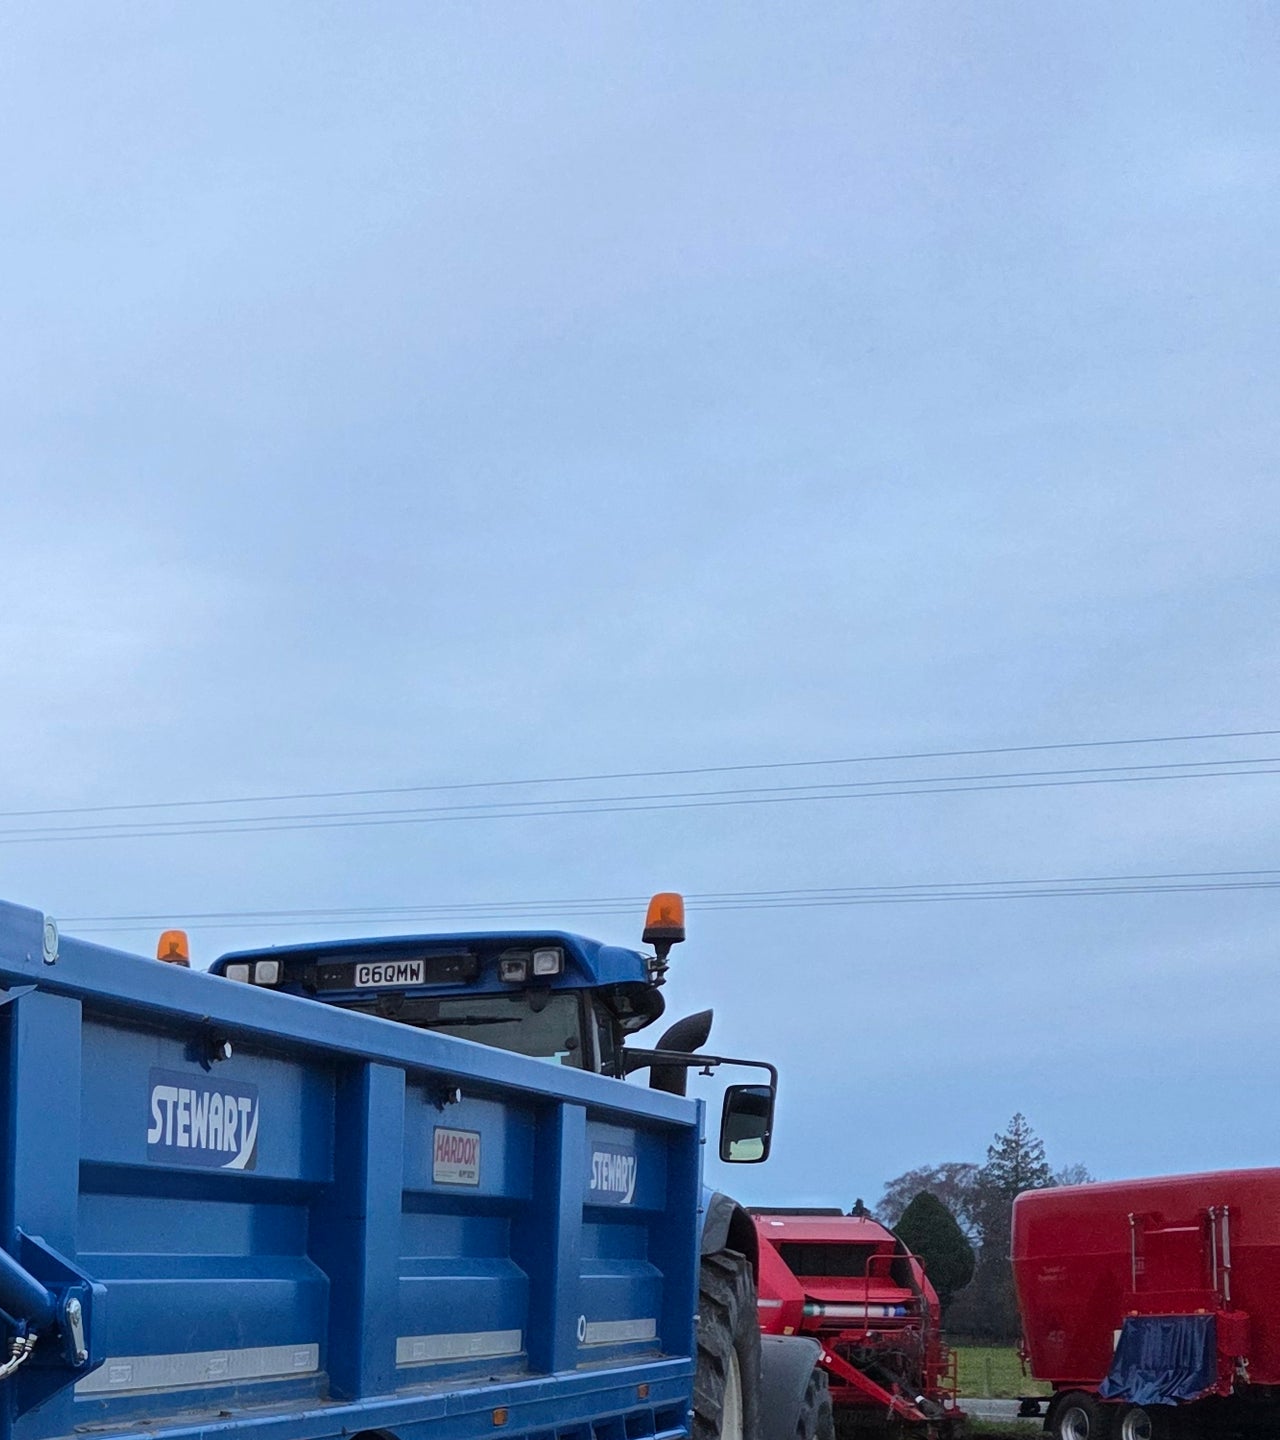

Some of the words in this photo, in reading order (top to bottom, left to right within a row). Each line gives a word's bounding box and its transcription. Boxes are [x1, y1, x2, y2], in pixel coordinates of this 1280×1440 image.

[147, 1085, 256, 1168] STEWART
[435, 1133, 478, 1166] HARDOX
[591, 1151, 637, 1202] STEWART
